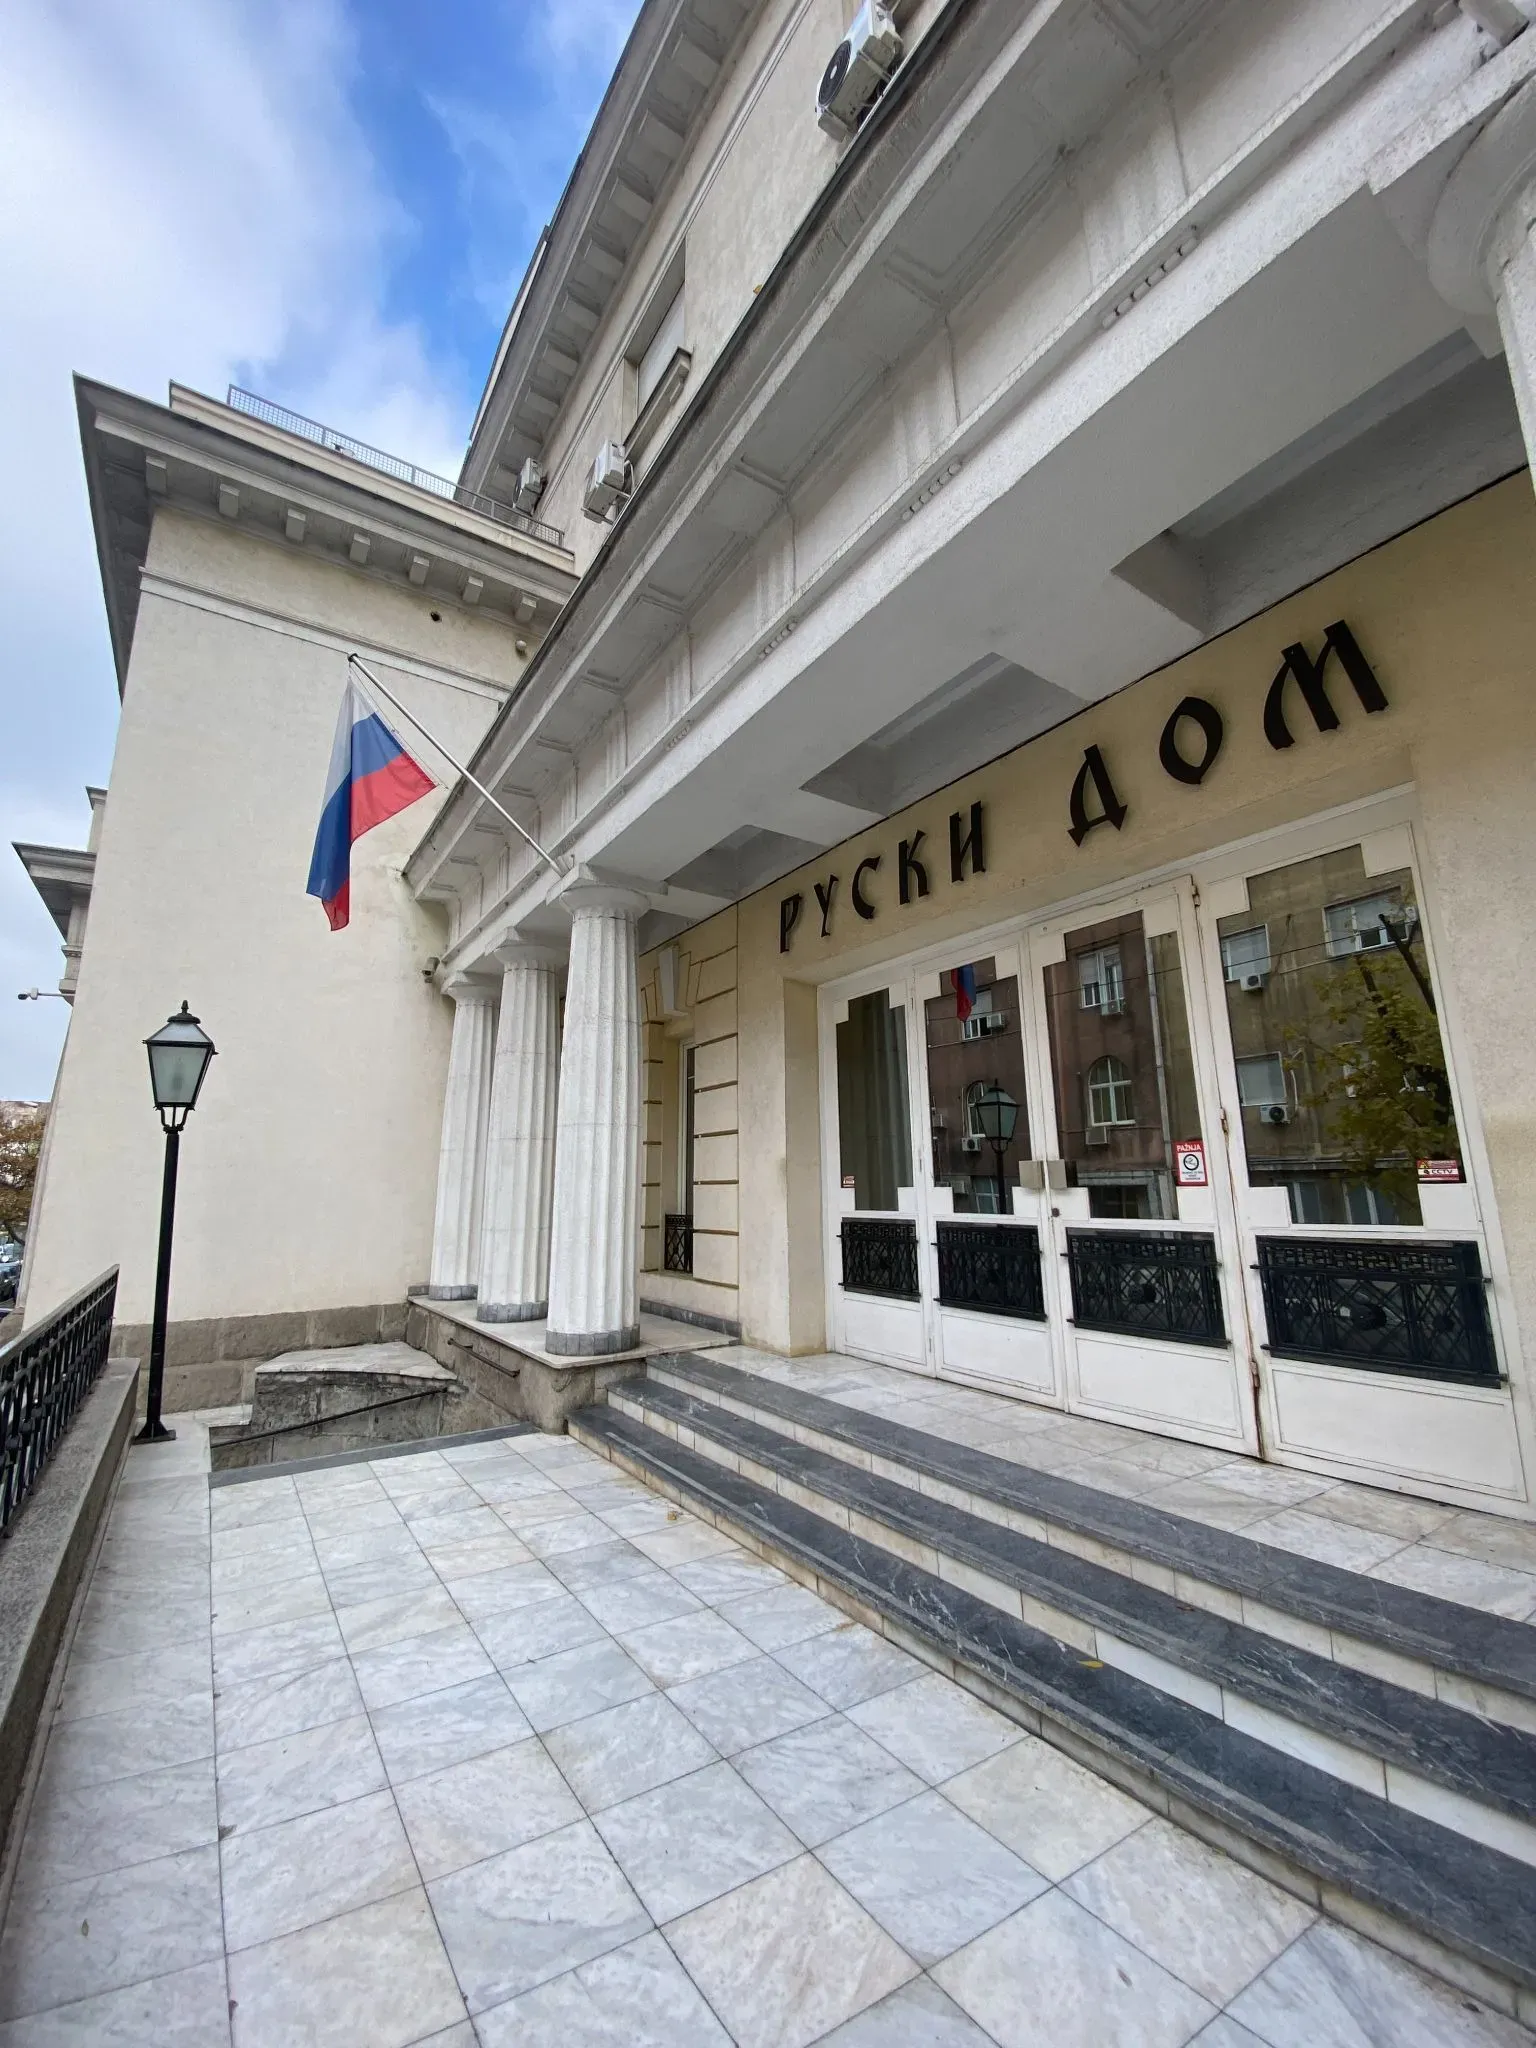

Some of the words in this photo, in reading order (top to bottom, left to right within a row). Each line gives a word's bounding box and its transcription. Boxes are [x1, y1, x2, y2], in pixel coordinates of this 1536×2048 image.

[780, 801, 986, 953] РУСКИ
[1067, 620, 1389, 848] ДОМ
[1176, 1143, 1202, 1152] PAŽNJA
